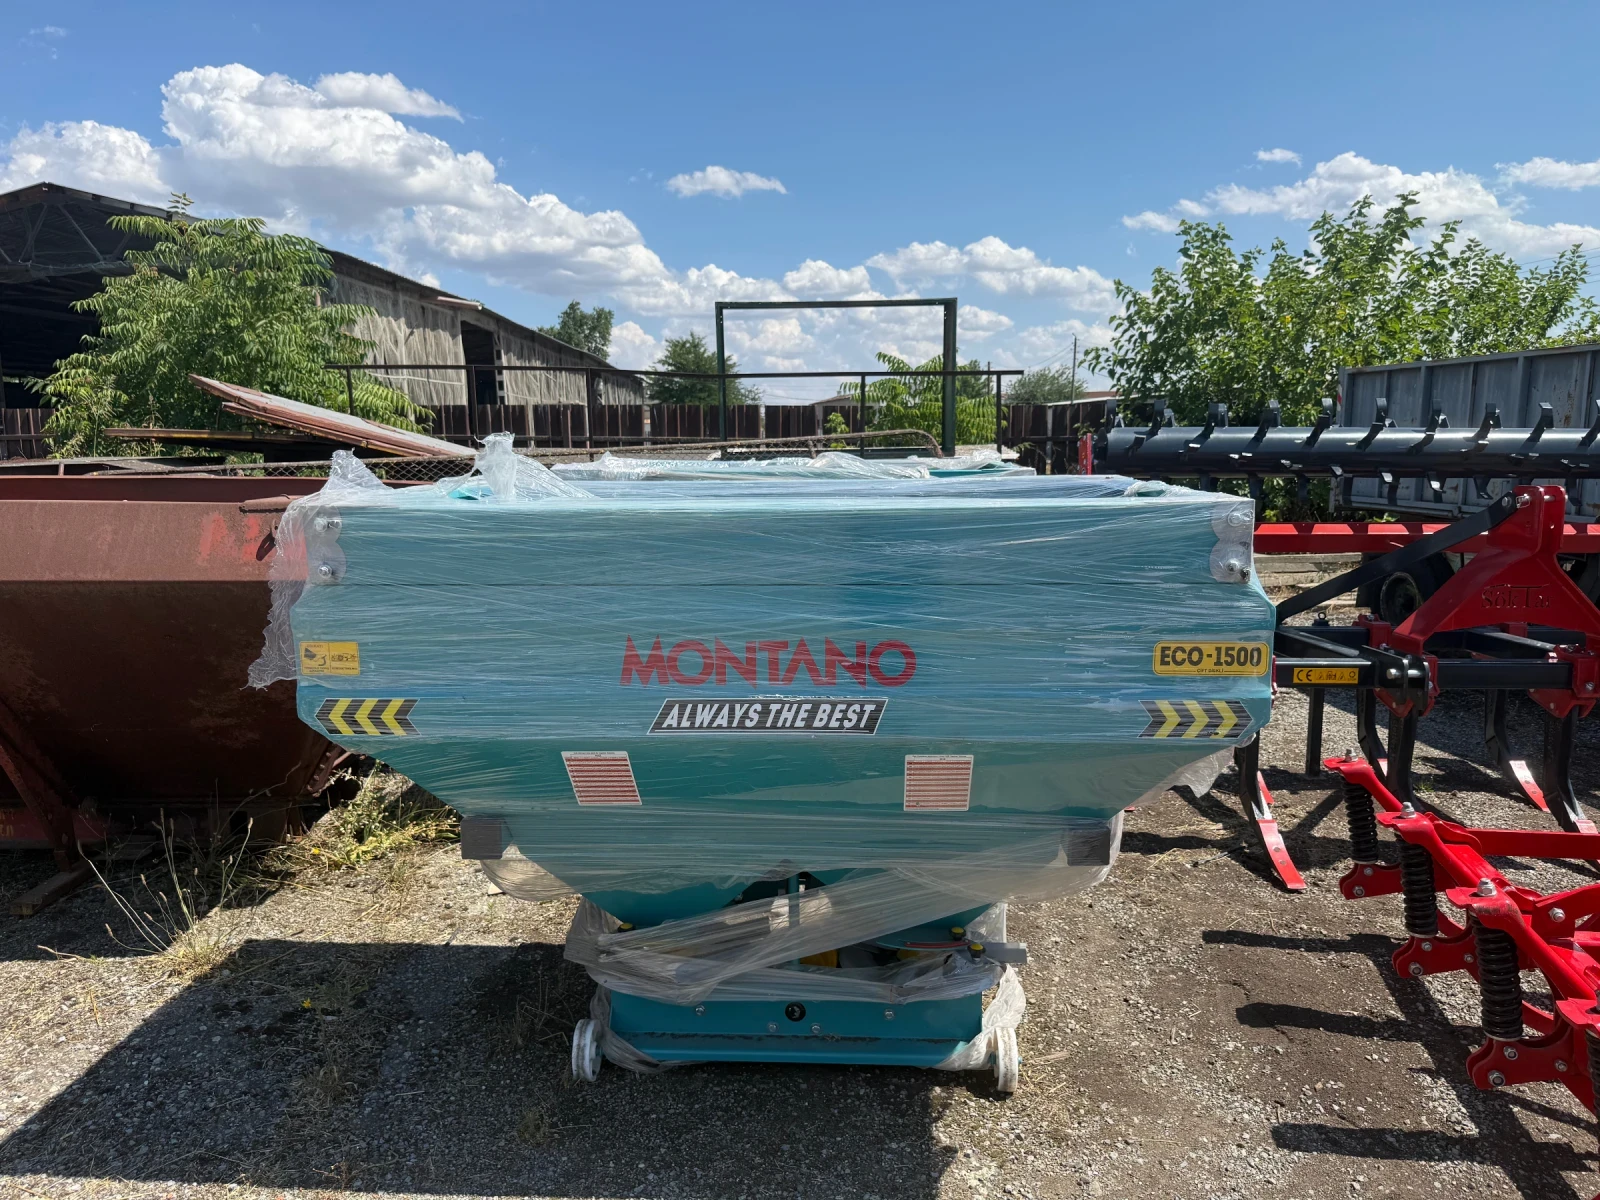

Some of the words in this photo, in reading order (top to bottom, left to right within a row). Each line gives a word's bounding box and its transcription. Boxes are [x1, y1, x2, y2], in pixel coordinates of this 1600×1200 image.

[620, 634, 917, 689] MONTANO
[1159, 646, 1262, 667] ECO-1500
[1296, 669, 1313, 682] CE
[661, 703, 762, 728] ALWAYS
[764, 703, 811, 728] THE
[814, 703, 876, 729] BEST
